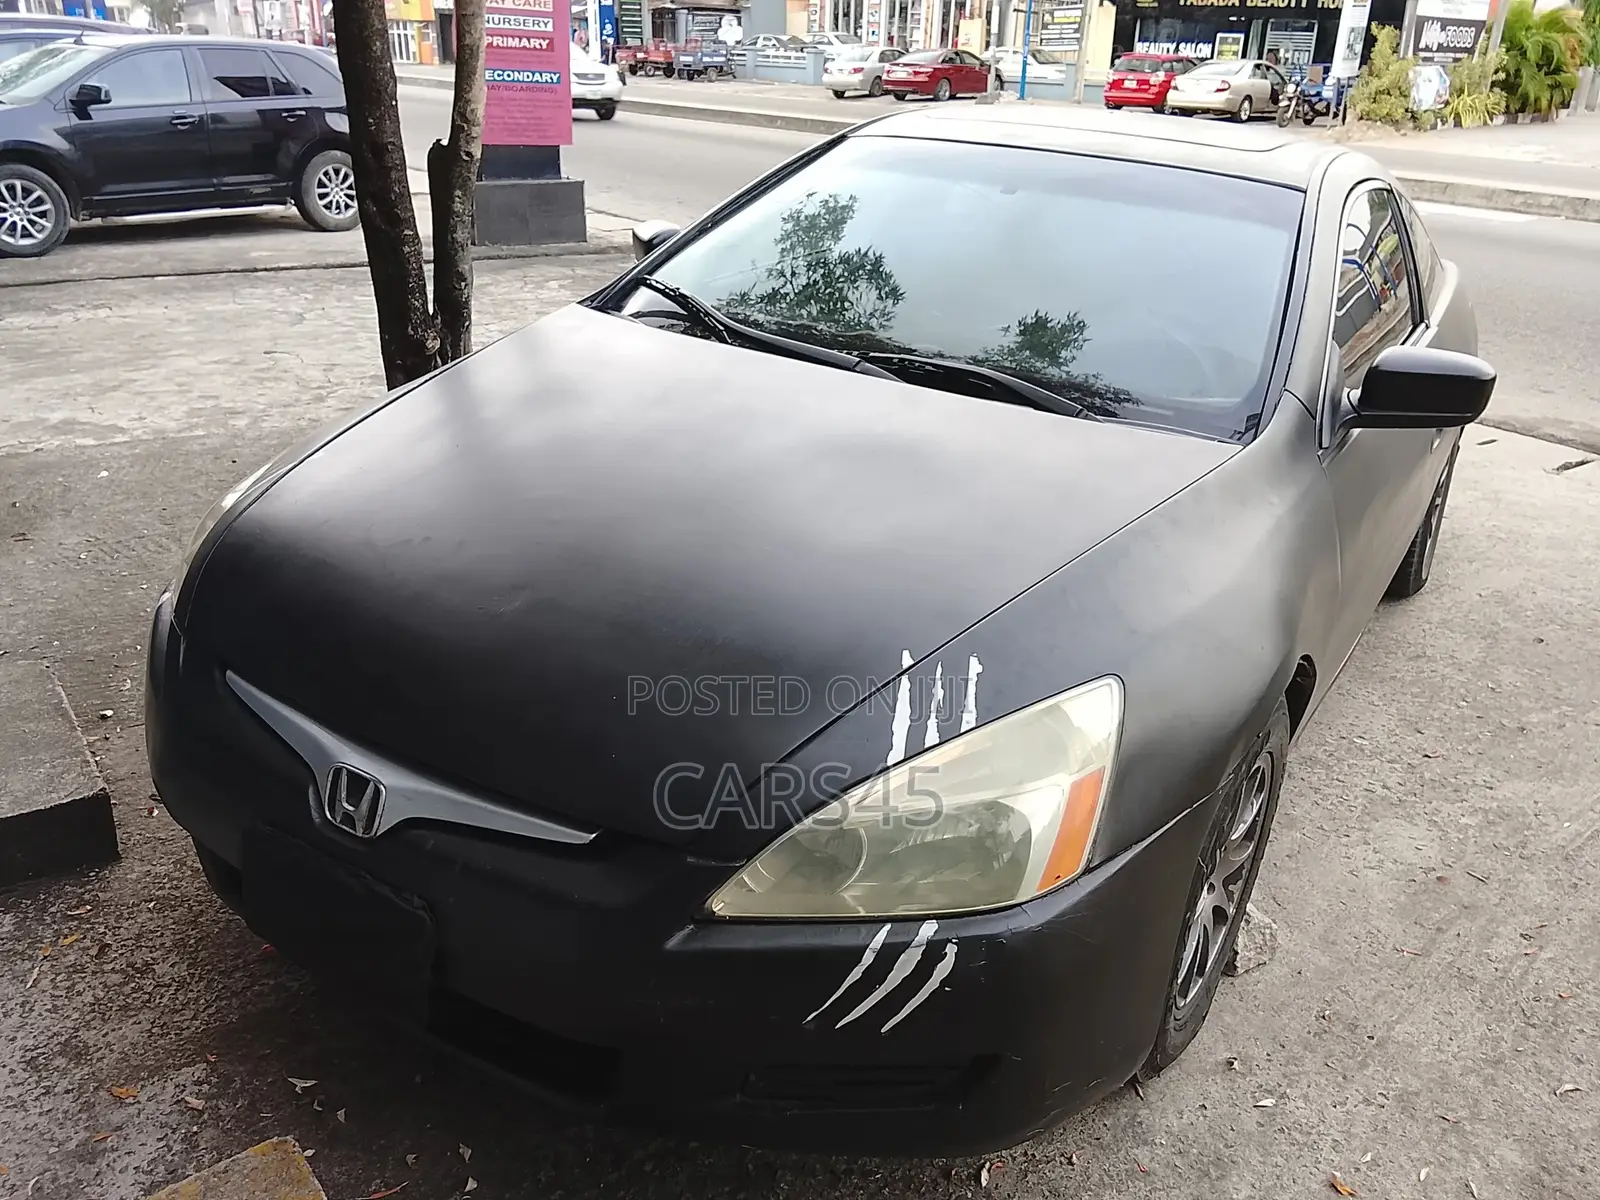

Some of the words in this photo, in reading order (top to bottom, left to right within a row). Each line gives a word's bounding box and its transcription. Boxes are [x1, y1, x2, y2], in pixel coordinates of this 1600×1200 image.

[512, 0, 551, 9] CARE
[485, 16, 550, 28] NURSERY
[485, 36, 550, 49] PRIMARY
[1443, 25, 1476, 48] FOODS
[1136, 42, 1177, 55] BEAUTY
[1178, 42, 1213, 59] SALON
[485, 70, 560, 83] ECONDARY
